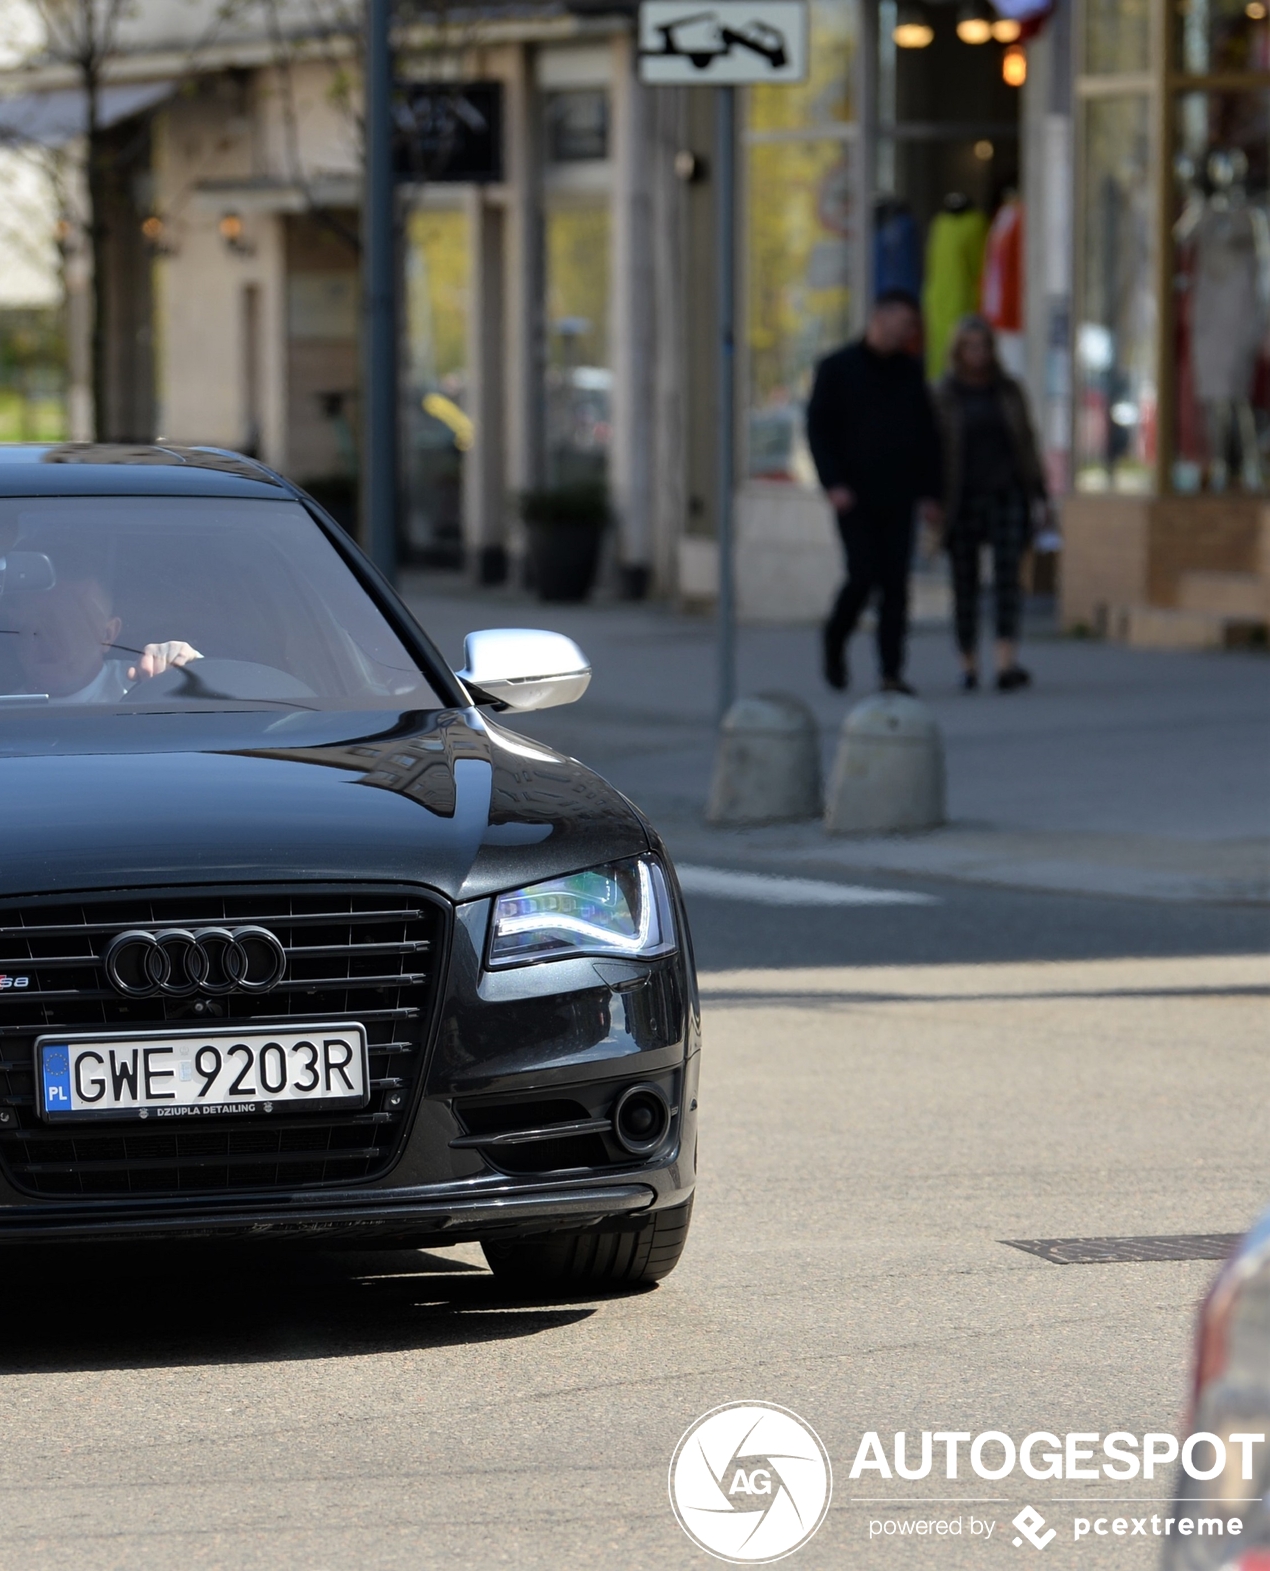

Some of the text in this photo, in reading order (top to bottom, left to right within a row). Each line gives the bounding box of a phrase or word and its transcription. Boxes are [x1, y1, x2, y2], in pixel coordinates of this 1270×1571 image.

[74, 1039, 355, 1102] GWE 9203R
[49, 1086, 67, 1101] PL
[157, 1103, 256, 1117] DZIUPLA DETAILING
